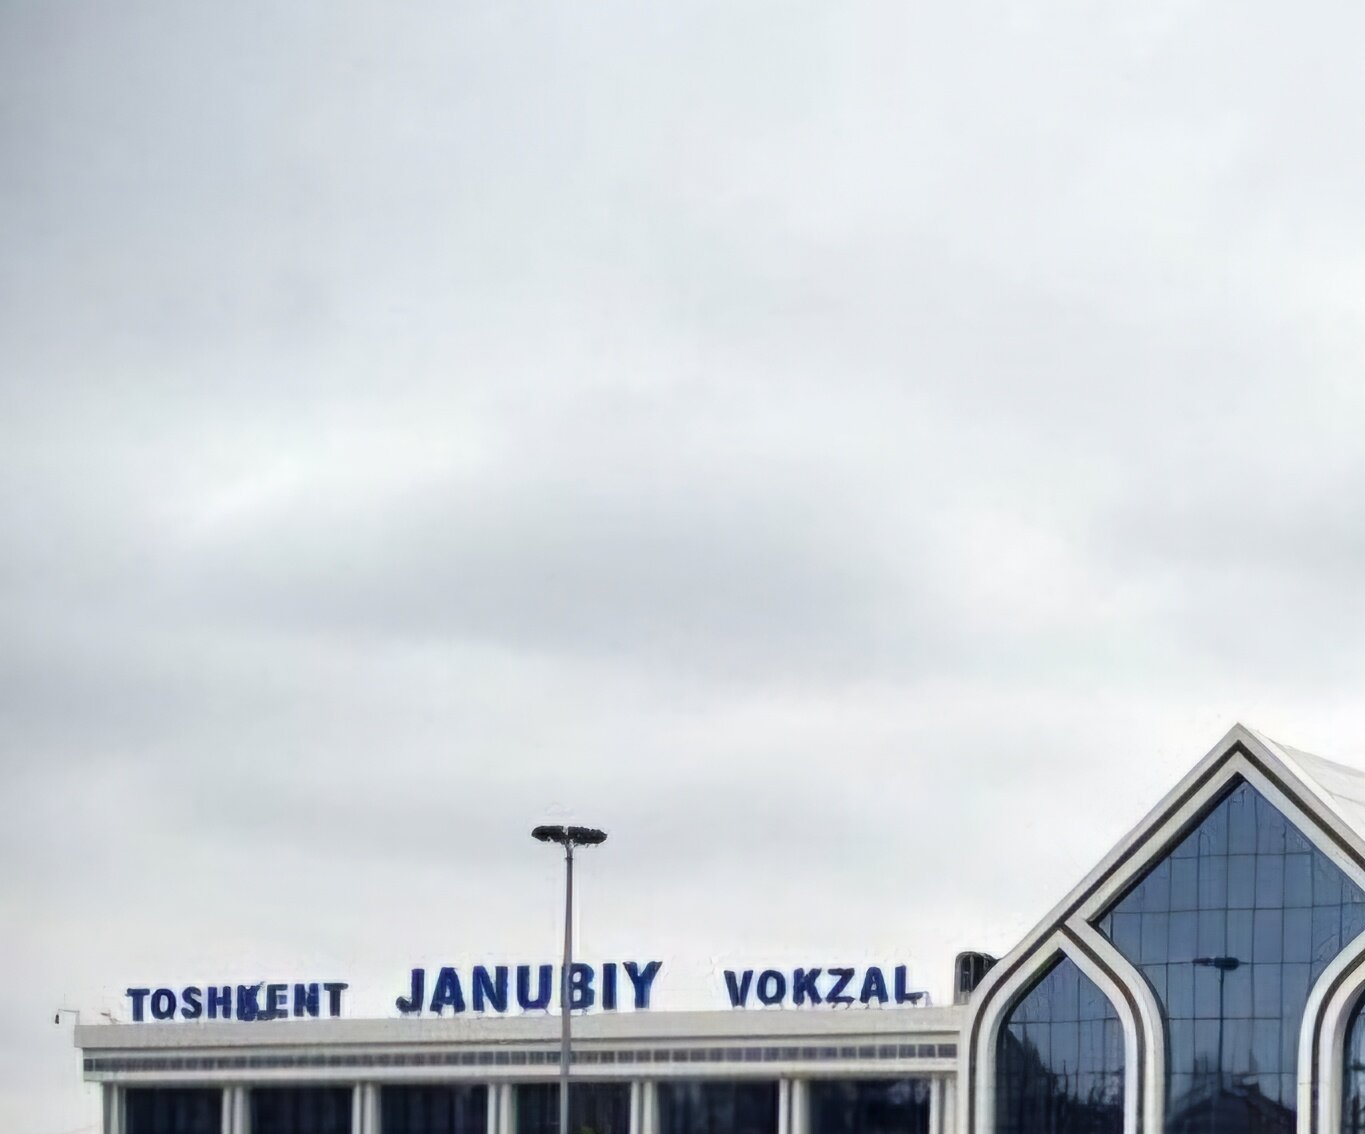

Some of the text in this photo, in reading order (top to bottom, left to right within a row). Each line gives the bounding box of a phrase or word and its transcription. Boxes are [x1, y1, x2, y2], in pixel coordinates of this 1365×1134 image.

[126, 961, 928, 1021] TOSHKENT JANUBIY VOKZAL
